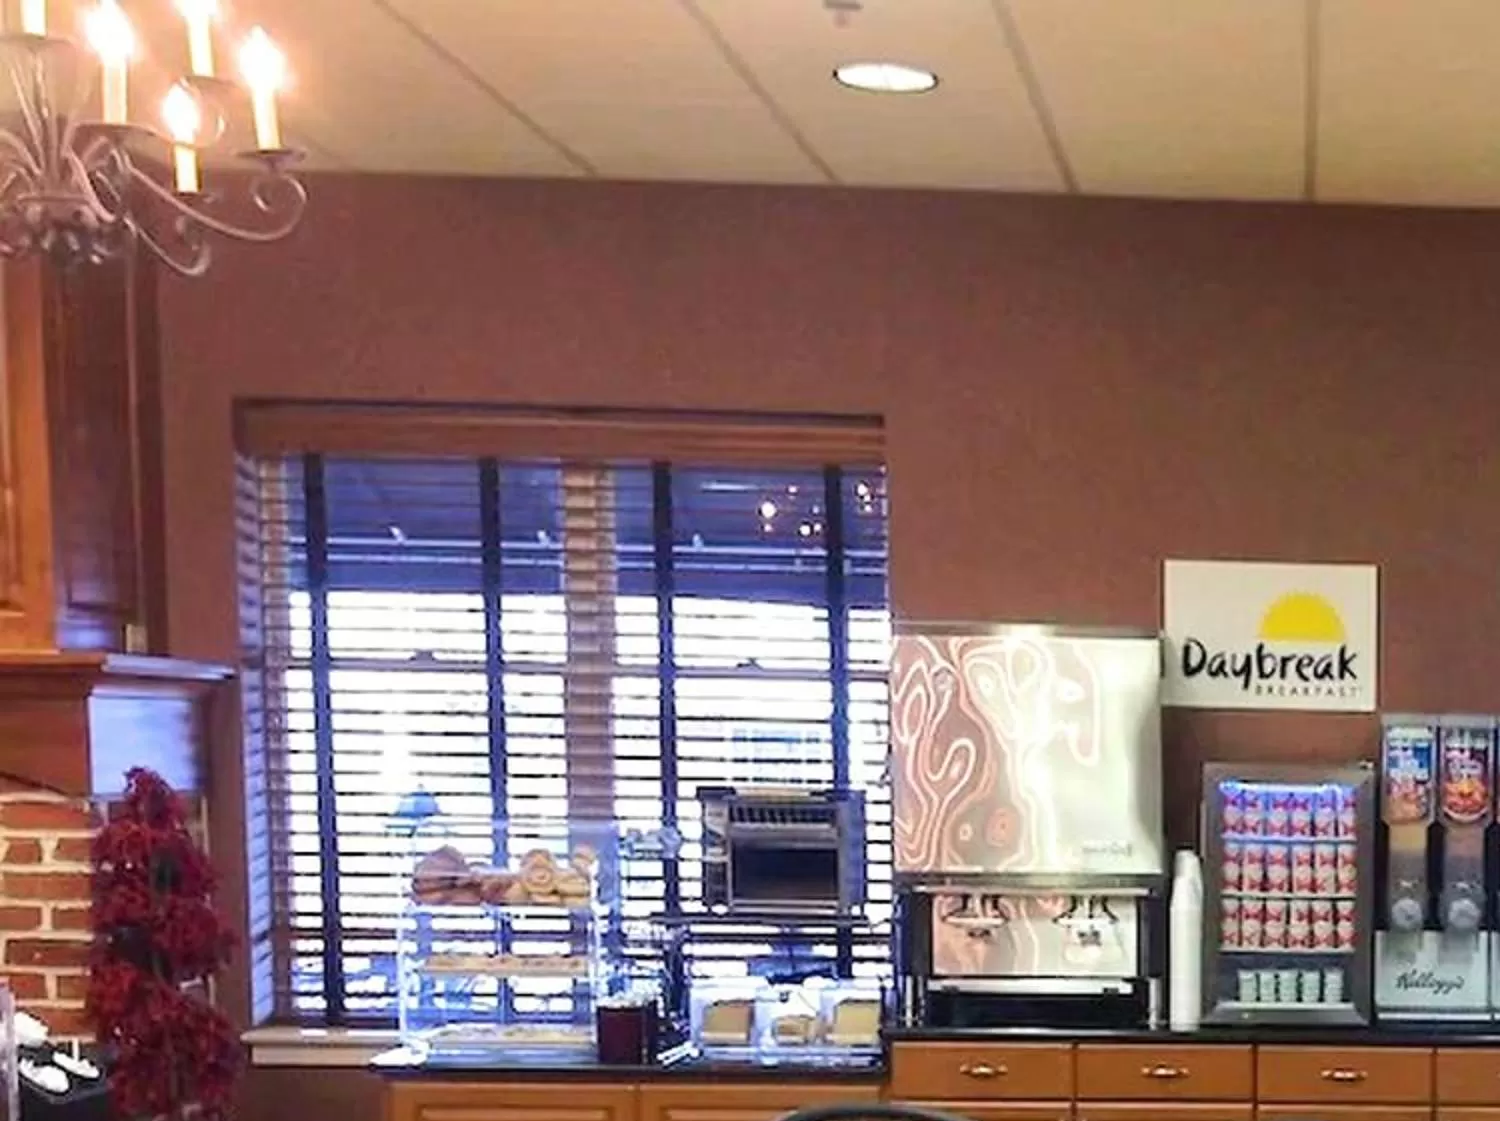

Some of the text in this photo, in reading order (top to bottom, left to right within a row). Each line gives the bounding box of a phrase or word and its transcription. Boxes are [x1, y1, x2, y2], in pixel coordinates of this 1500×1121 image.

[1183, 638, 1358, 690] Daybreak
[1255, 684, 1361, 697] BREAKFAST
[1394, 968, 1465, 994] Kellogg's
